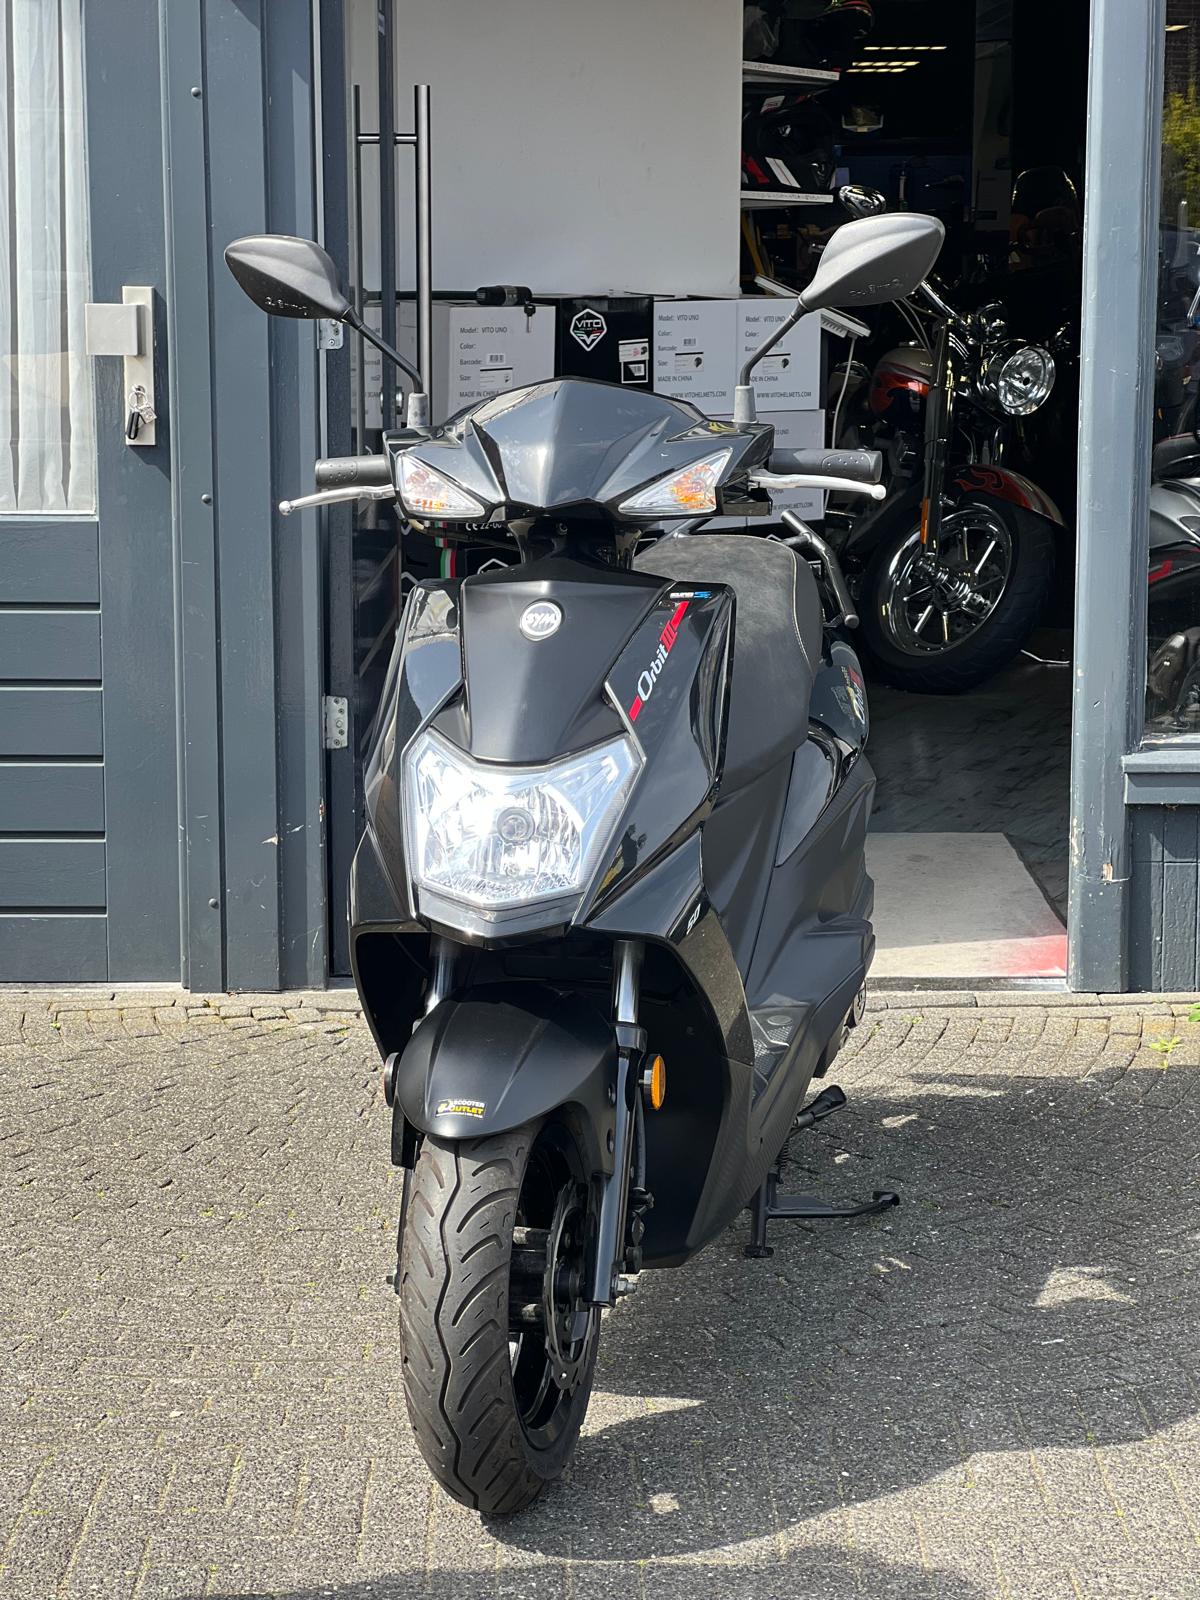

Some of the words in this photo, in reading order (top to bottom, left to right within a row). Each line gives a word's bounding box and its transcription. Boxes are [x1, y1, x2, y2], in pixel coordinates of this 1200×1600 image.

[637, 643, 669, 702] Orbit
[453, 1099, 485, 1107] SCOOTER
[449, 1105, 484, 1114] OUTLET
